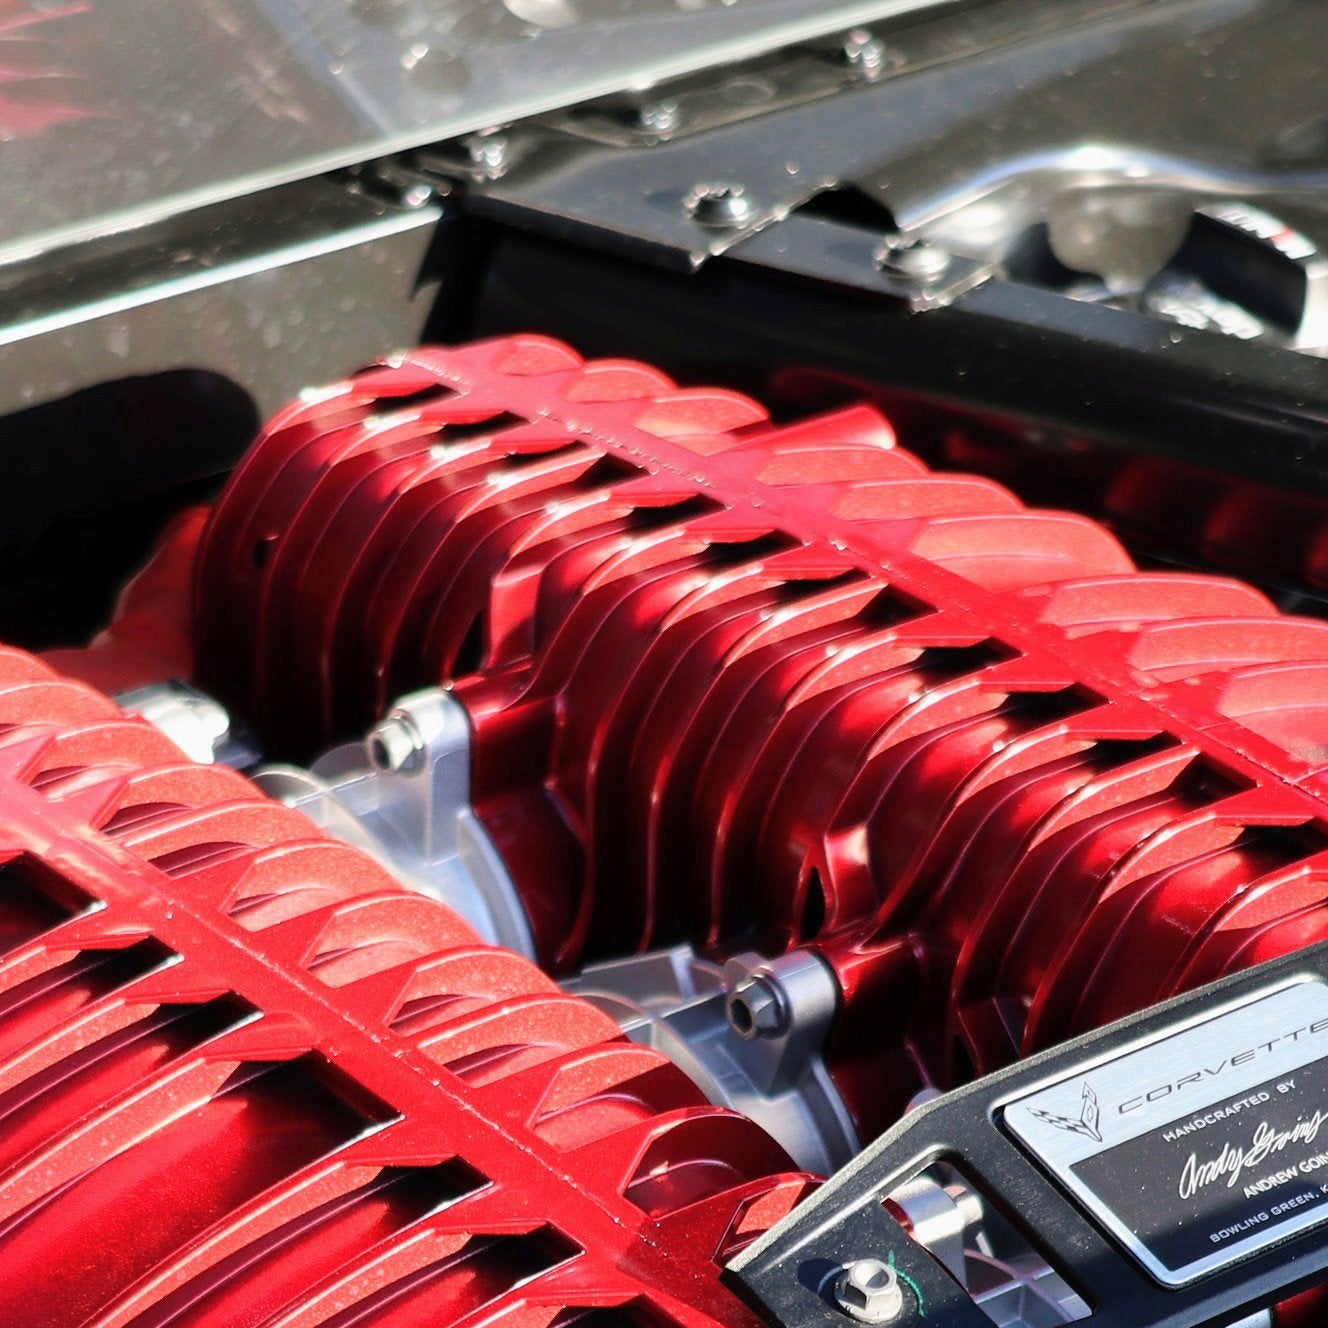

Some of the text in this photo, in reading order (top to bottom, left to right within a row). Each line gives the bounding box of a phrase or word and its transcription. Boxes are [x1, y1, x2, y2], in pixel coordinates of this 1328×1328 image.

[1162, 1079, 1296, 1142] HANDCRAFTED BY
[1243, 1166, 1298, 1198] ANDREW
[1209, 1212, 1269, 1243] BOWLING
[1271, 1192, 1319, 1216] GREEN,
